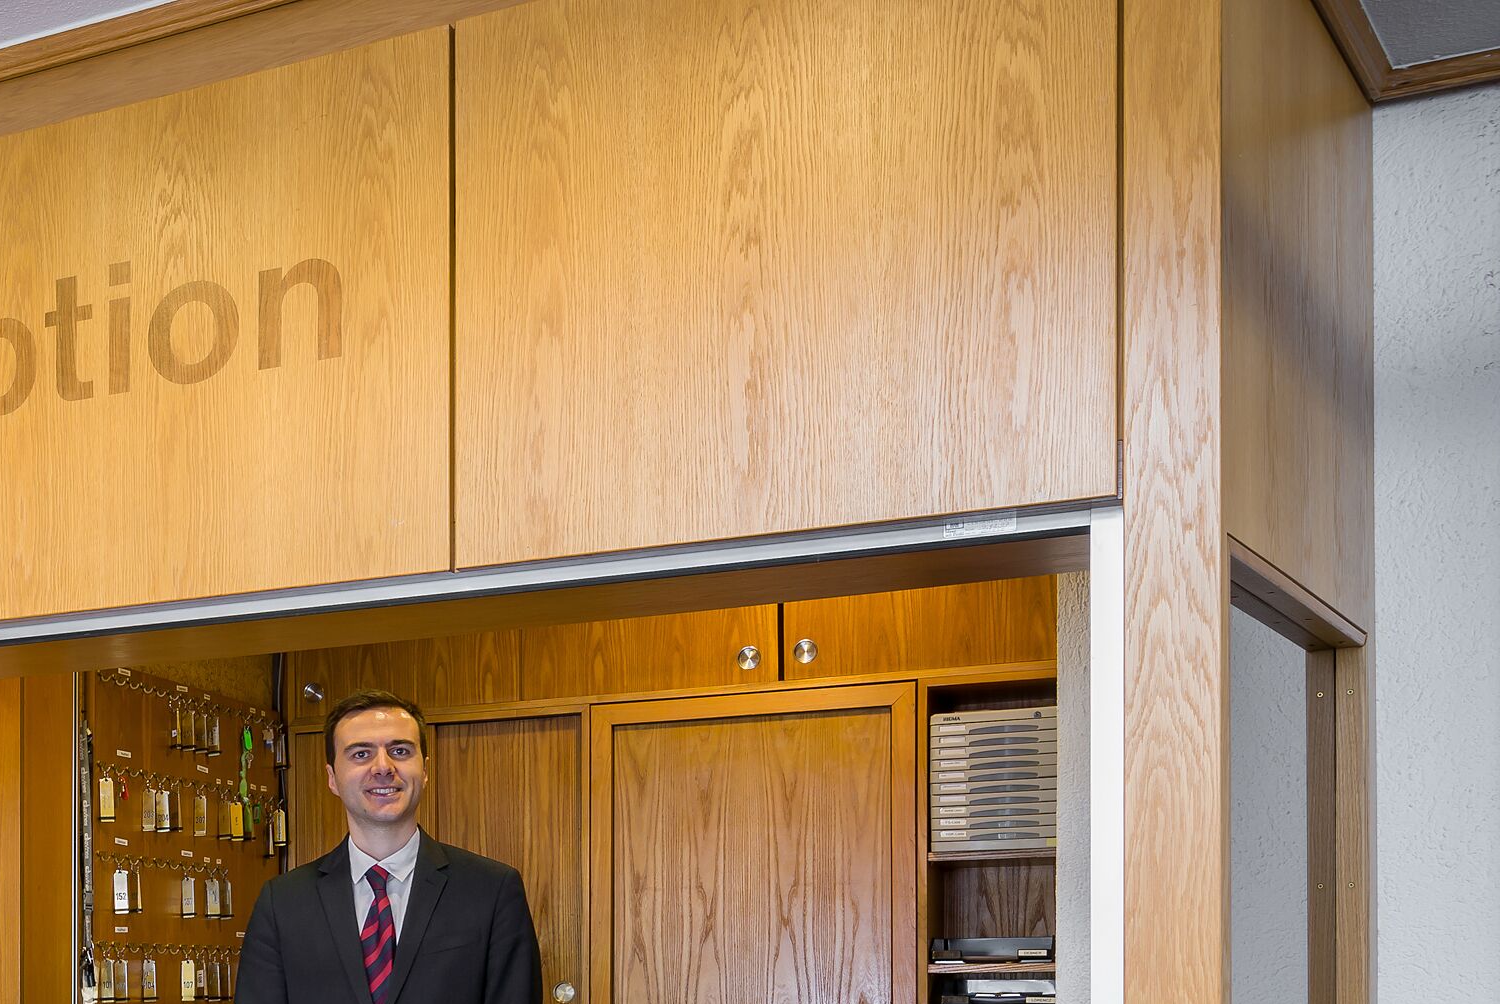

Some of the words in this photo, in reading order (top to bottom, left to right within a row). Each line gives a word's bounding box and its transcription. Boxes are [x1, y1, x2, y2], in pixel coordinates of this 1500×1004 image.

[115, 892, 126, 900] 152
[102, 980, 112, 989] 101
[183, 980, 193, 989] 107
